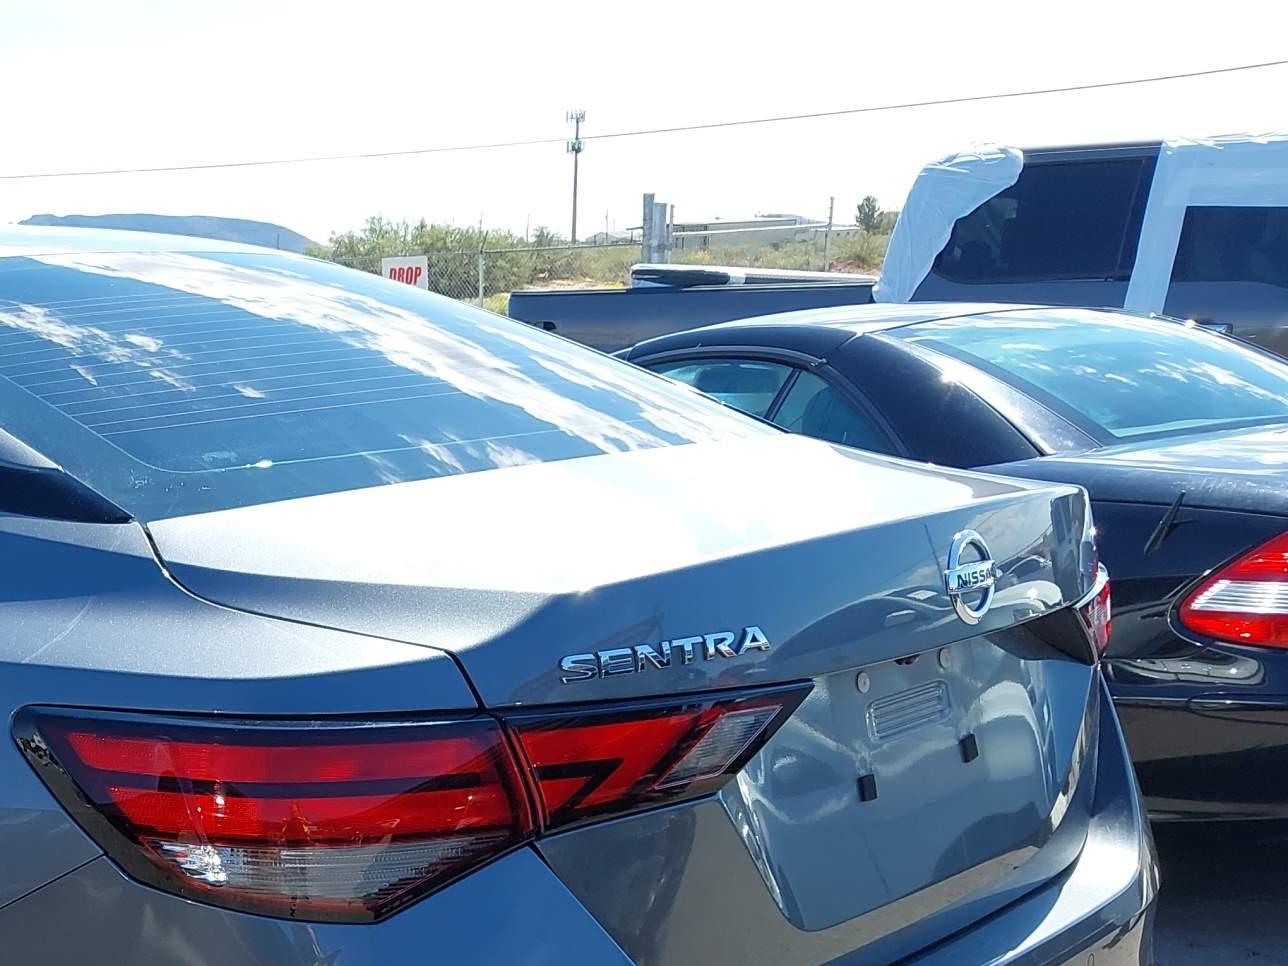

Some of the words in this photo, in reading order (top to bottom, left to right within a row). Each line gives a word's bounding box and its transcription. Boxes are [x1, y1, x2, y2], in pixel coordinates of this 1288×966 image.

[389, 266, 422, 286] DROP
[957, 567, 995, 588] NISSA
[560, 626, 771, 685] SENTRA
